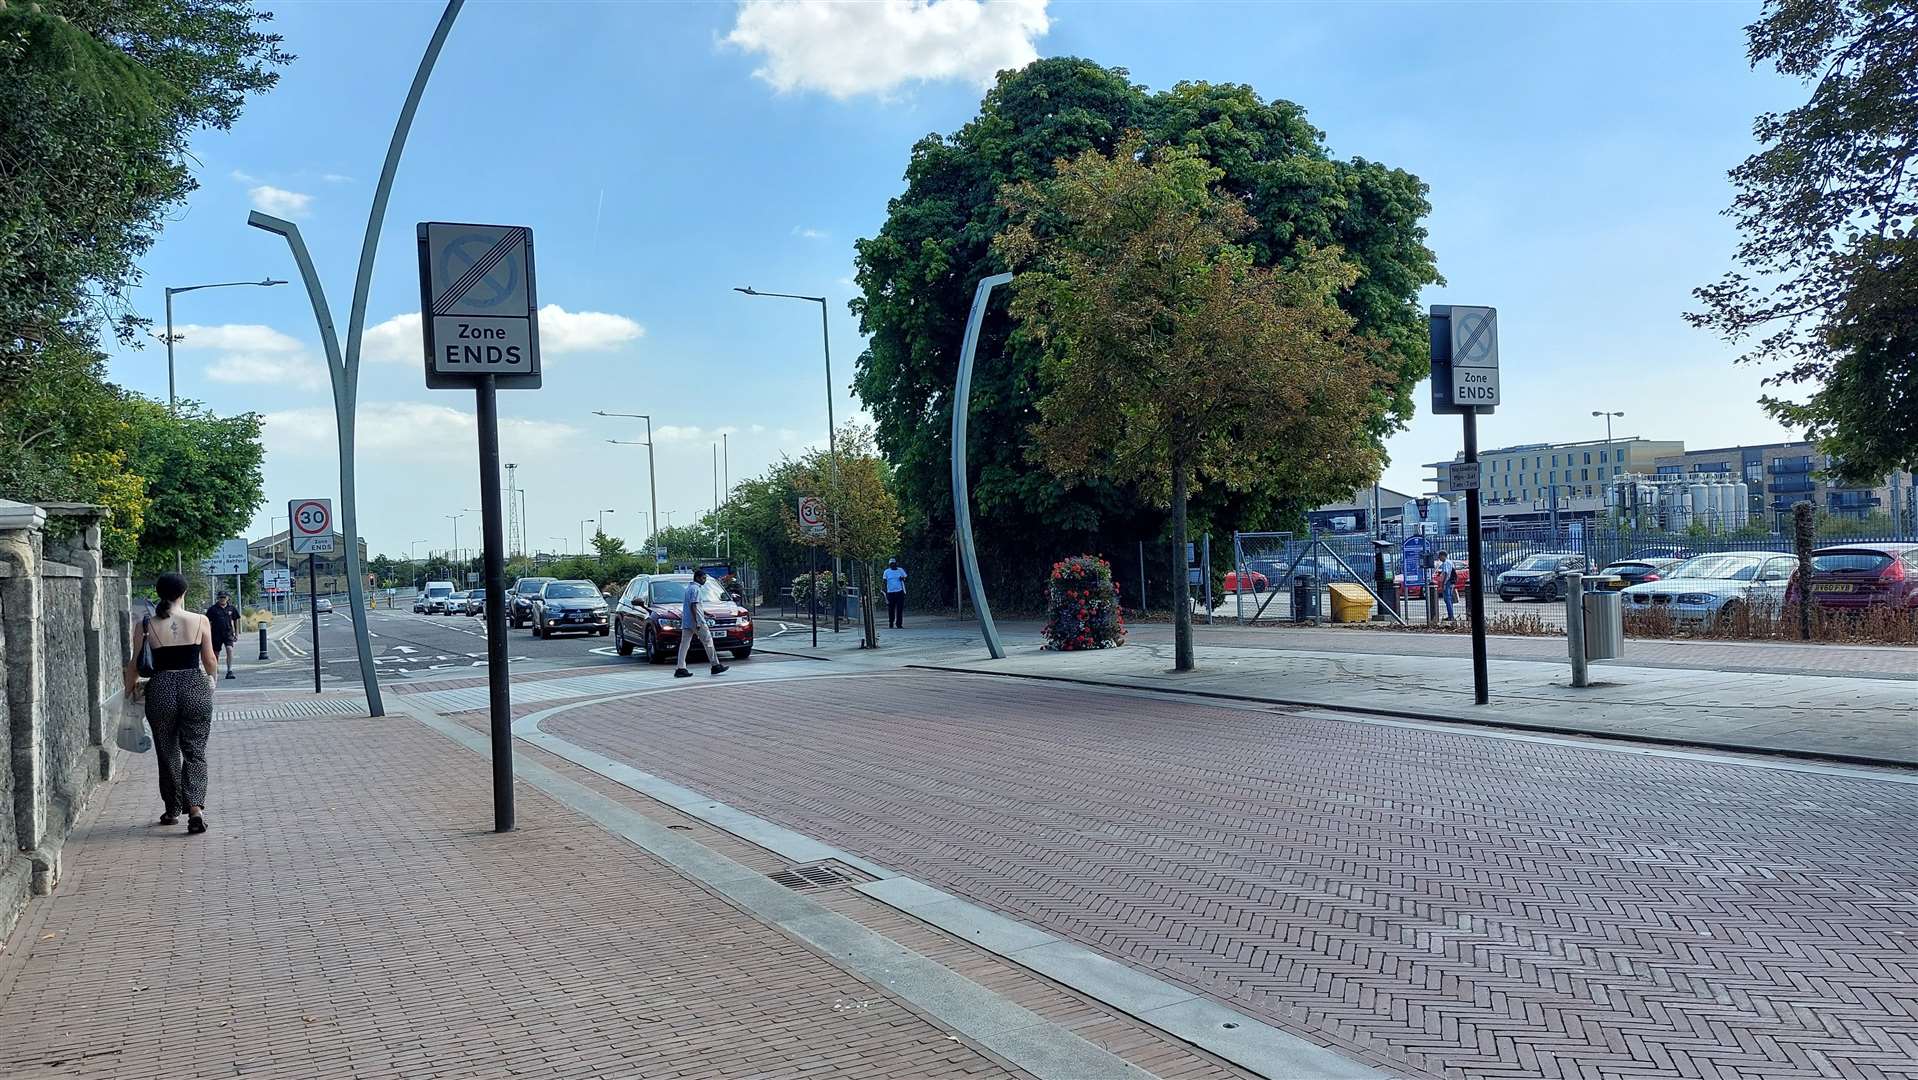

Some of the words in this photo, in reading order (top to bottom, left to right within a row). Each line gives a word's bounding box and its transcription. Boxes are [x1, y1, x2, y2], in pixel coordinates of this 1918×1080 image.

[458, 323, 506, 339] Zone
[446, 345, 521, 364] ENDS
[1464, 372, 1488, 383] Zone
[1459, 386, 1494, 399] ENDS
[300, 511, 324, 524] 30
